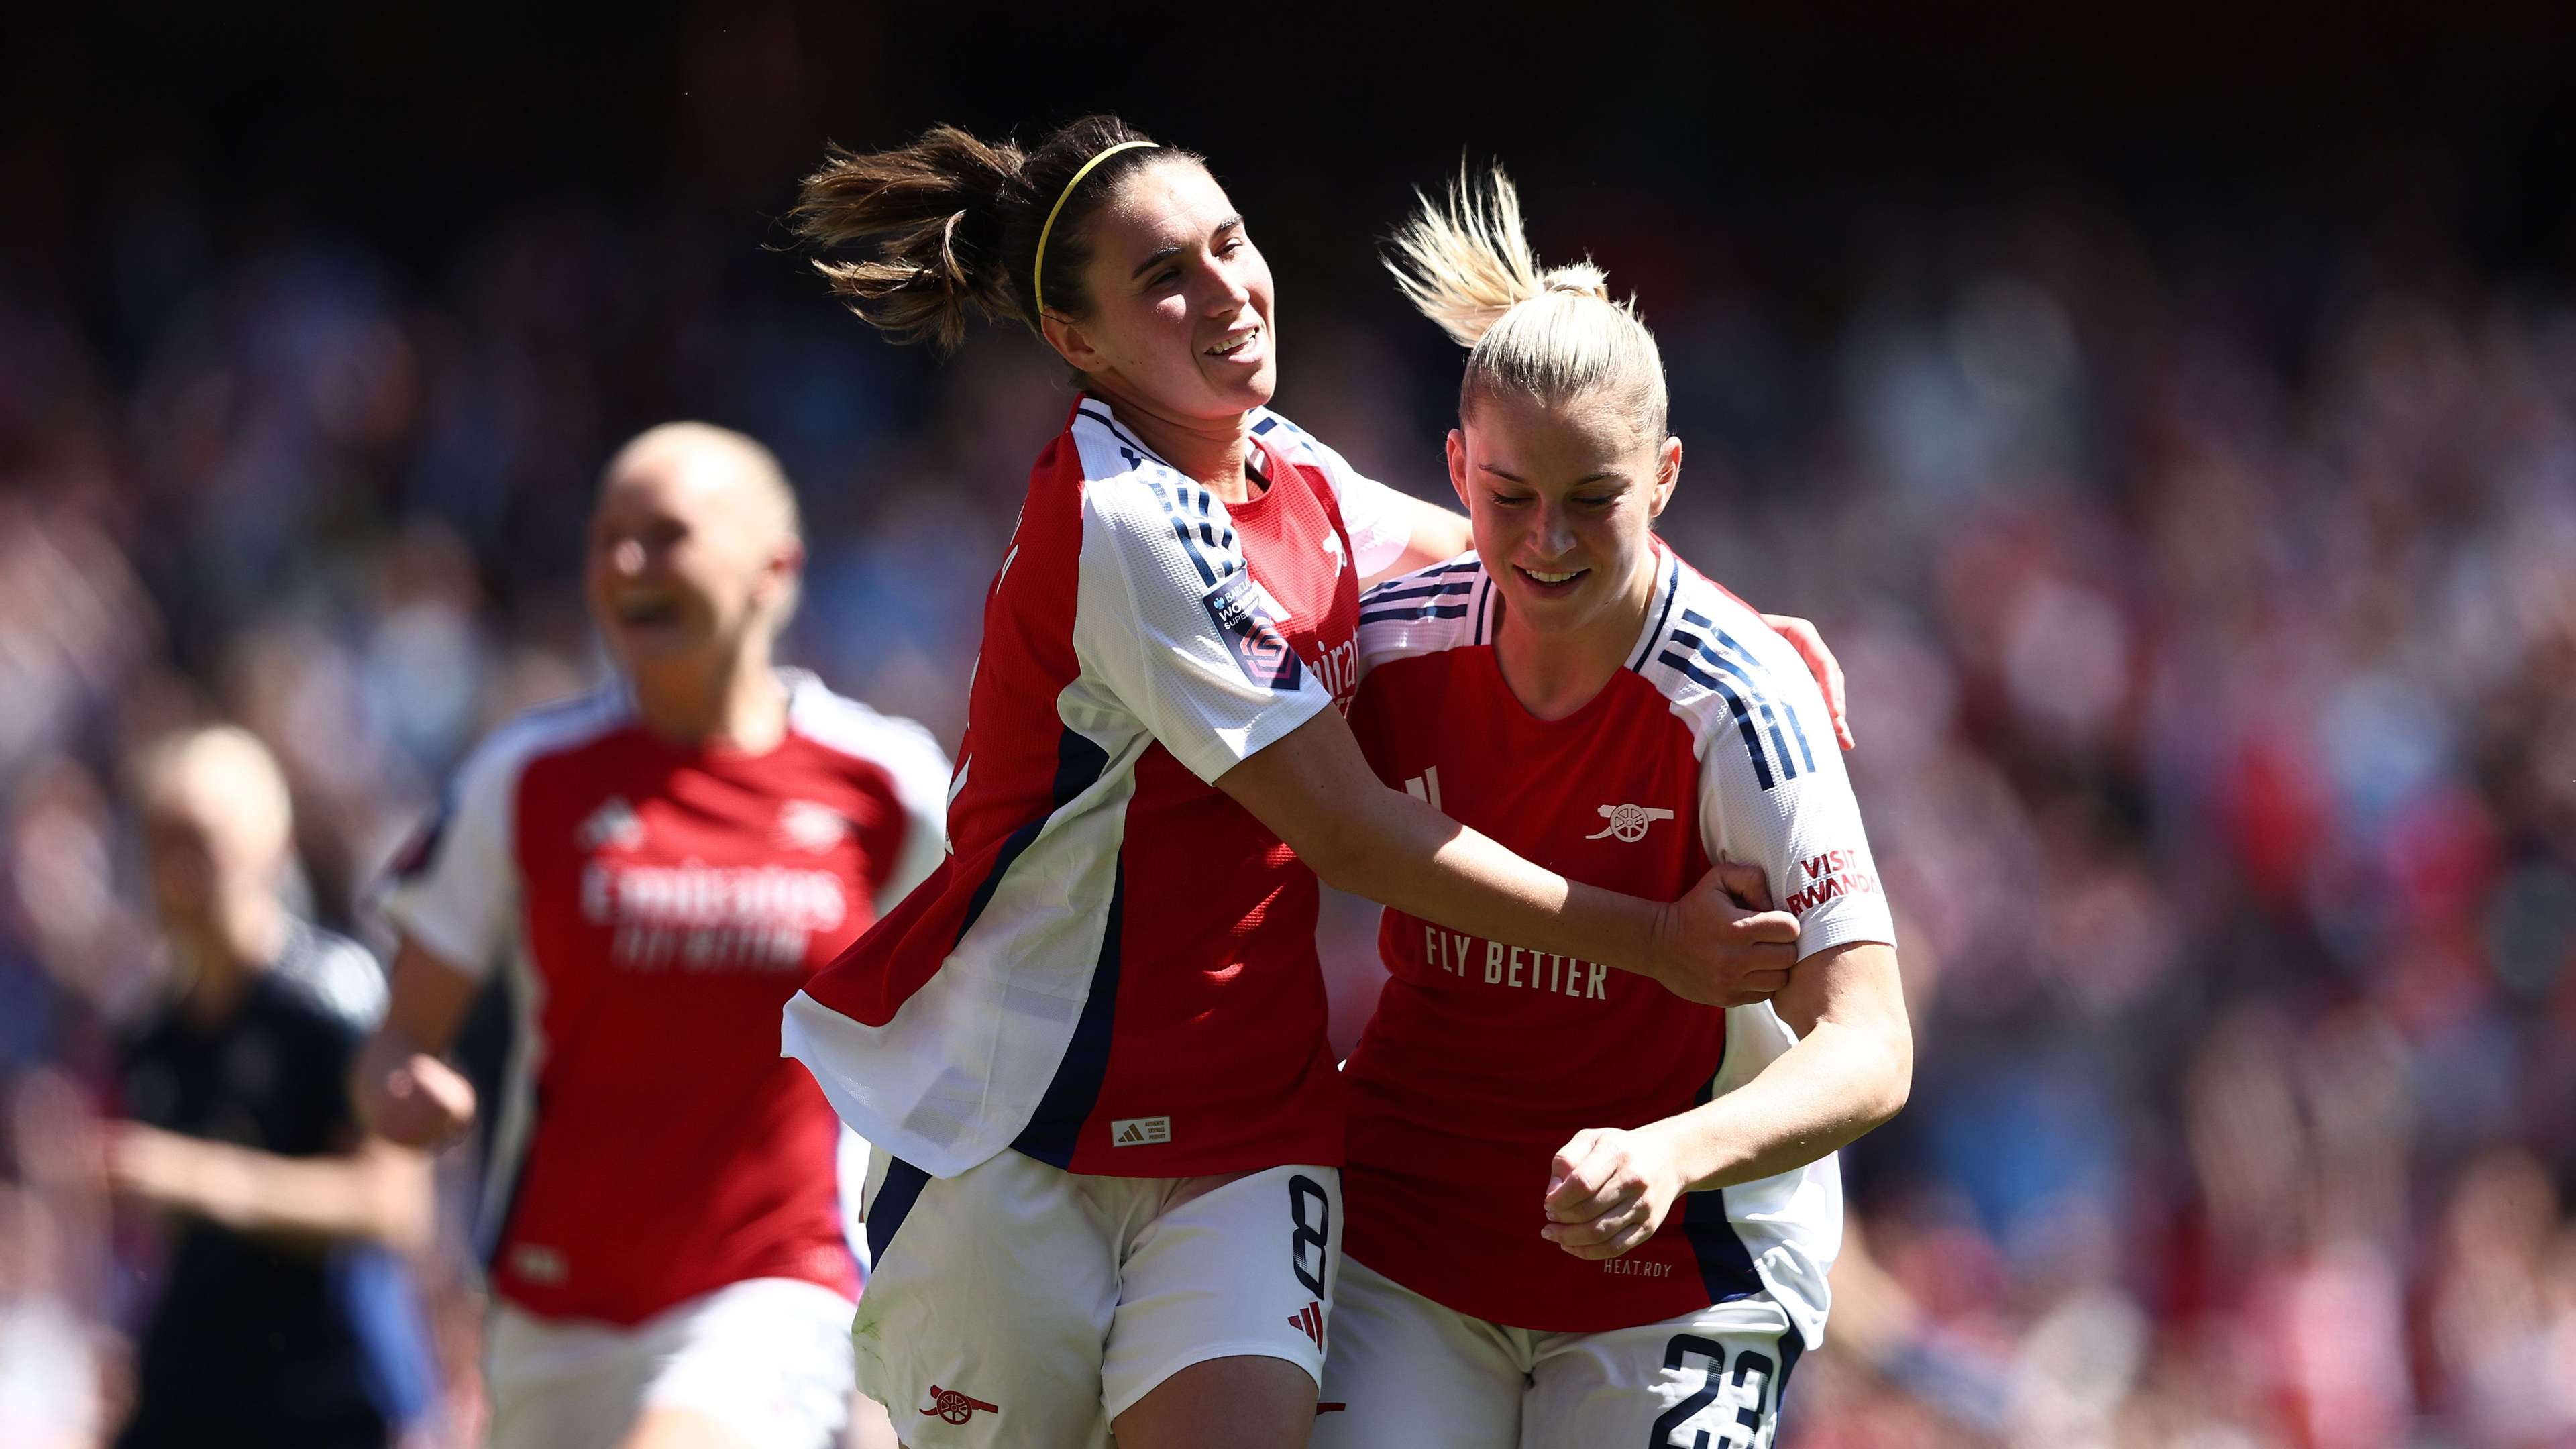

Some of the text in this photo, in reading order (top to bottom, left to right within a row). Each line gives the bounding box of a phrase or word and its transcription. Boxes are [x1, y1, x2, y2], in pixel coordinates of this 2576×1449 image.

[1801, 849, 1857, 879] VISIT
[1425, 926, 1607, 1000] FLY BETTER
[1288, 1174, 1329, 1301] 8
[1603, 1258, 1672, 1278] HEAT.RDY
[1648, 1333, 1774, 1449] 23
